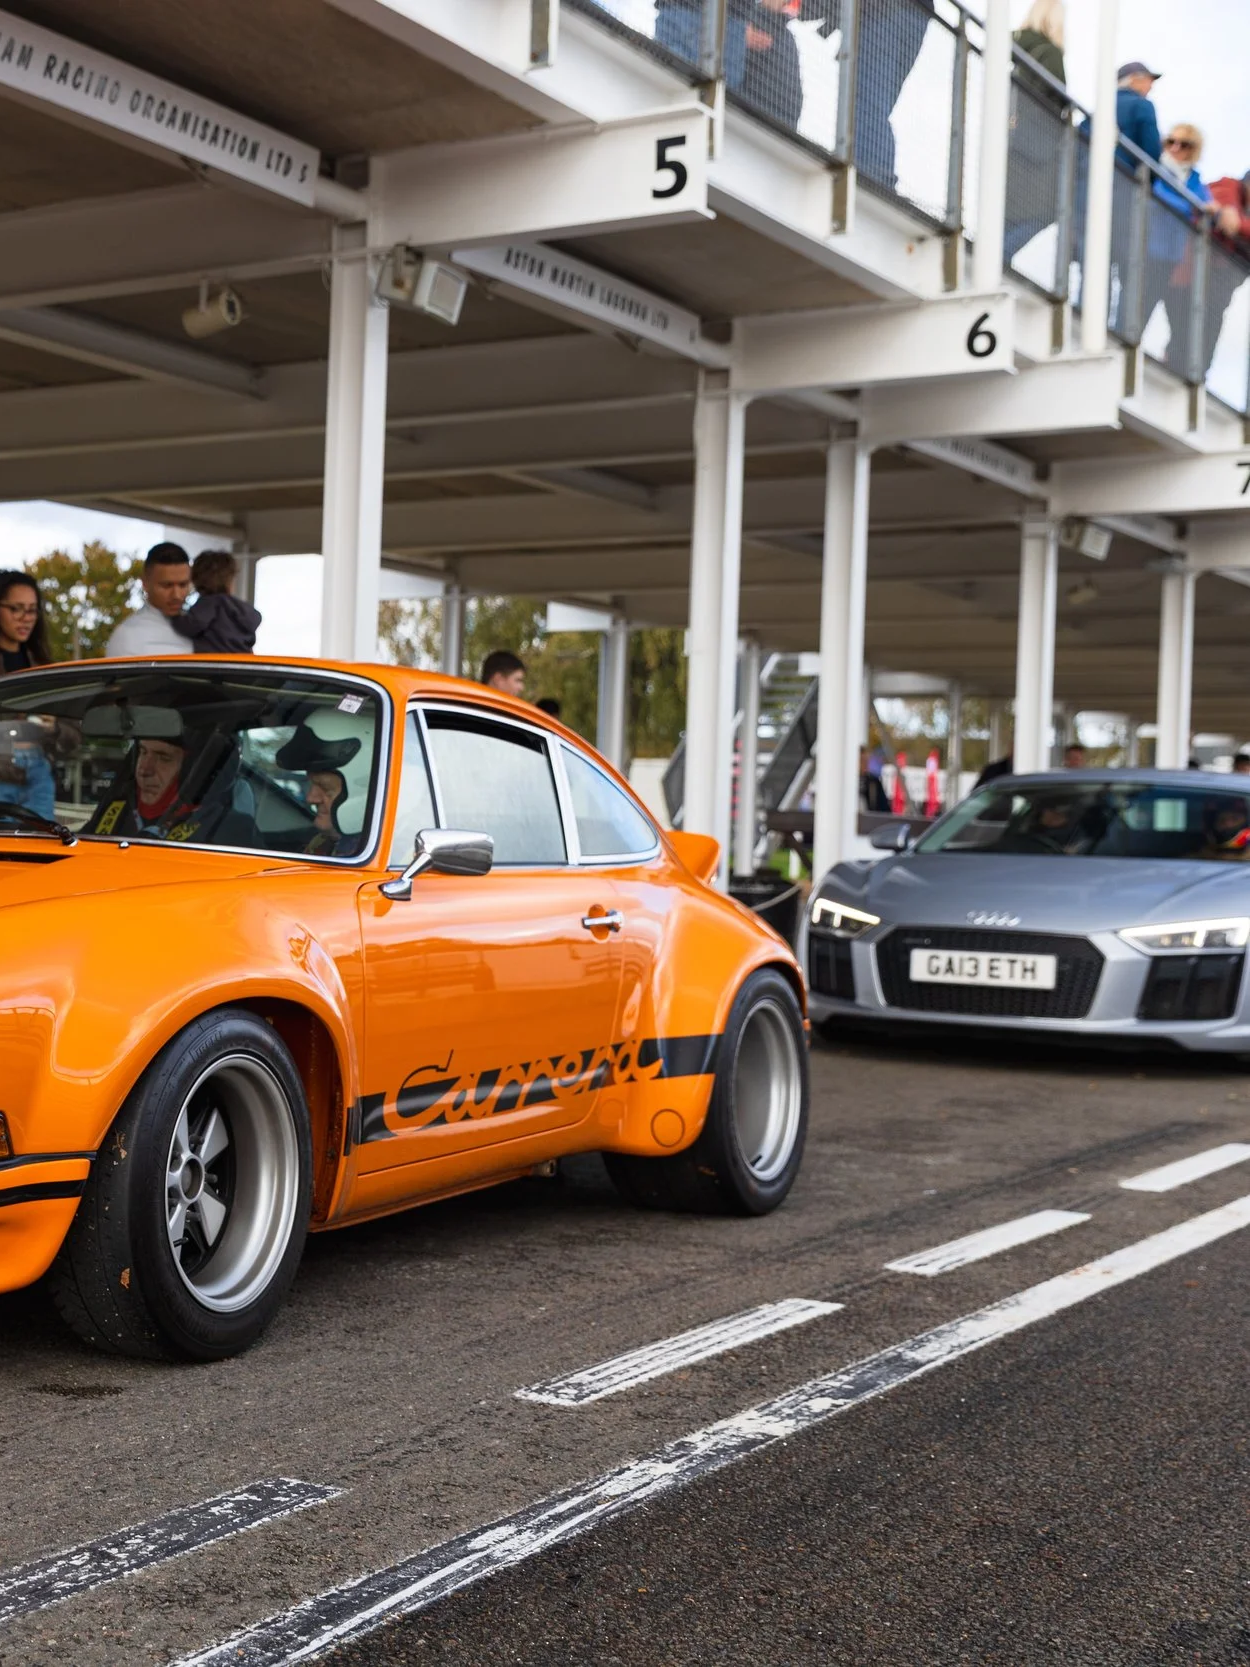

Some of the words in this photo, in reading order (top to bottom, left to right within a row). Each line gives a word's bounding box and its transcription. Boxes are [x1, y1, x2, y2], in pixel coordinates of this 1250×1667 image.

[43, 54, 121, 106] RACING
[129, 89, 261, 164] ORGANISATION
[266, 148, 293, 178] LTD
[651, 135, 688, 198] 5
[504, 246, 546, 280] ASTON
[550, 265, 596, 299] MARTIN
[966, 312, 998, 358] 6
[927, 955, 980, 978] GA13
[987, 958, 1037, 980] ETH
[383, 1042, 664, 1134] Carrera
